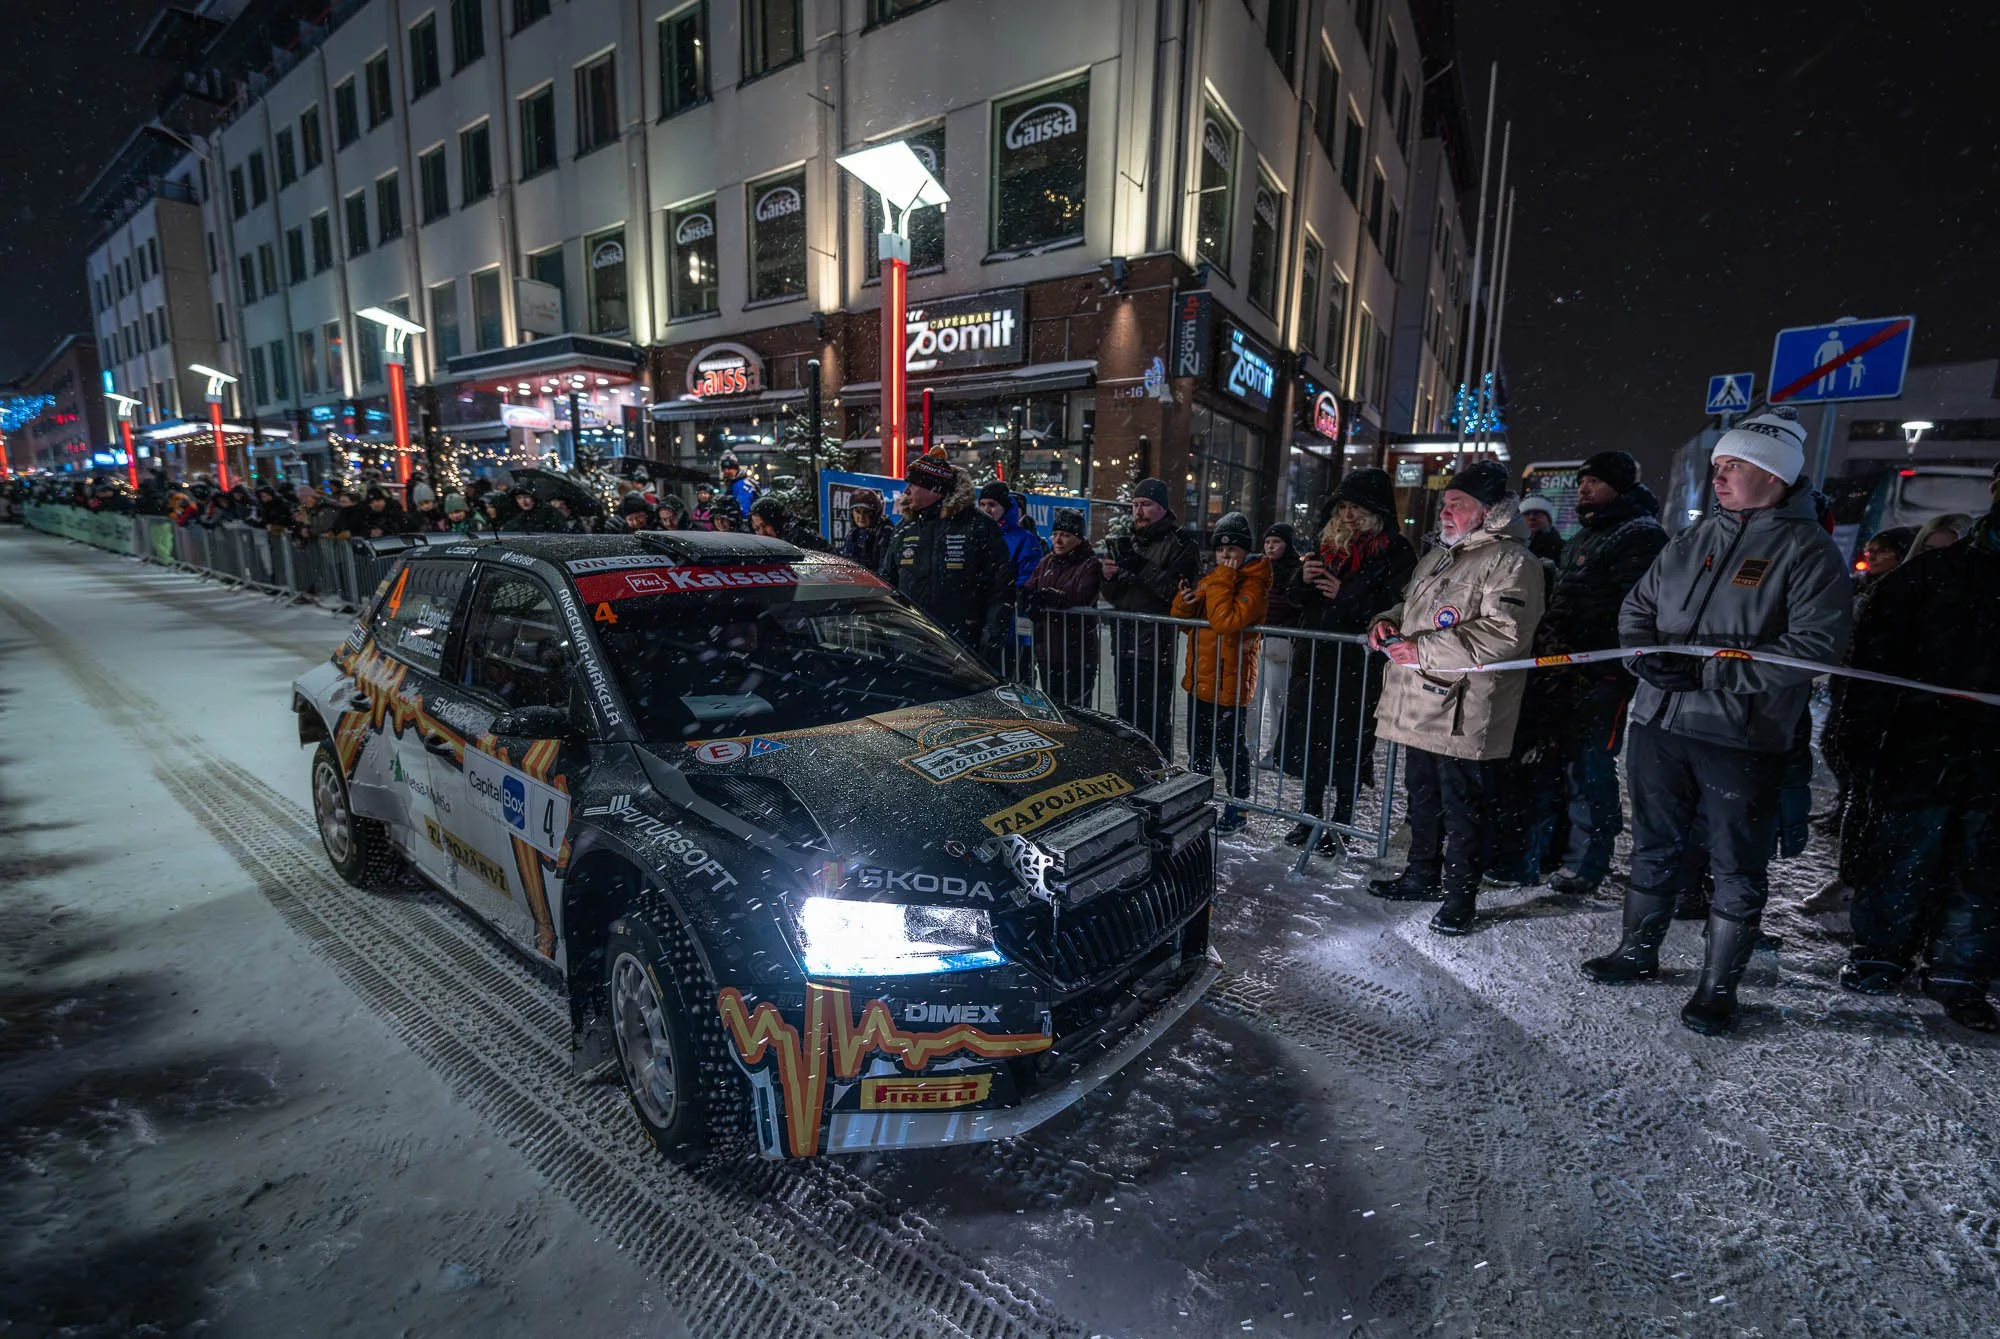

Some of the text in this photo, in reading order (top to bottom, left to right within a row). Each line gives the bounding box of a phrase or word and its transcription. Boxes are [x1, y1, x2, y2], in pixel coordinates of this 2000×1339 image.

[1006, 104, 1076, 150] Gaissa
[756, 189, 800, 222] Gaissa
[906, 309, 1015, 371] Zoomit
[1228, 340, 1274, 399] Zoomit
[388, 566, 410, 620] 4
[594, 602, 619, 624] 4
[709, 744, 733, 759] E
[937, 740, 1047, 777] MOTORSPORT
[543, 798, 555, 849] 4
[611, 806, 739, 892] FUTURSOFT
[905, 1003, 1000, 1023] DIMEX
[875, 1082, 978, 1103] PIRELLI
